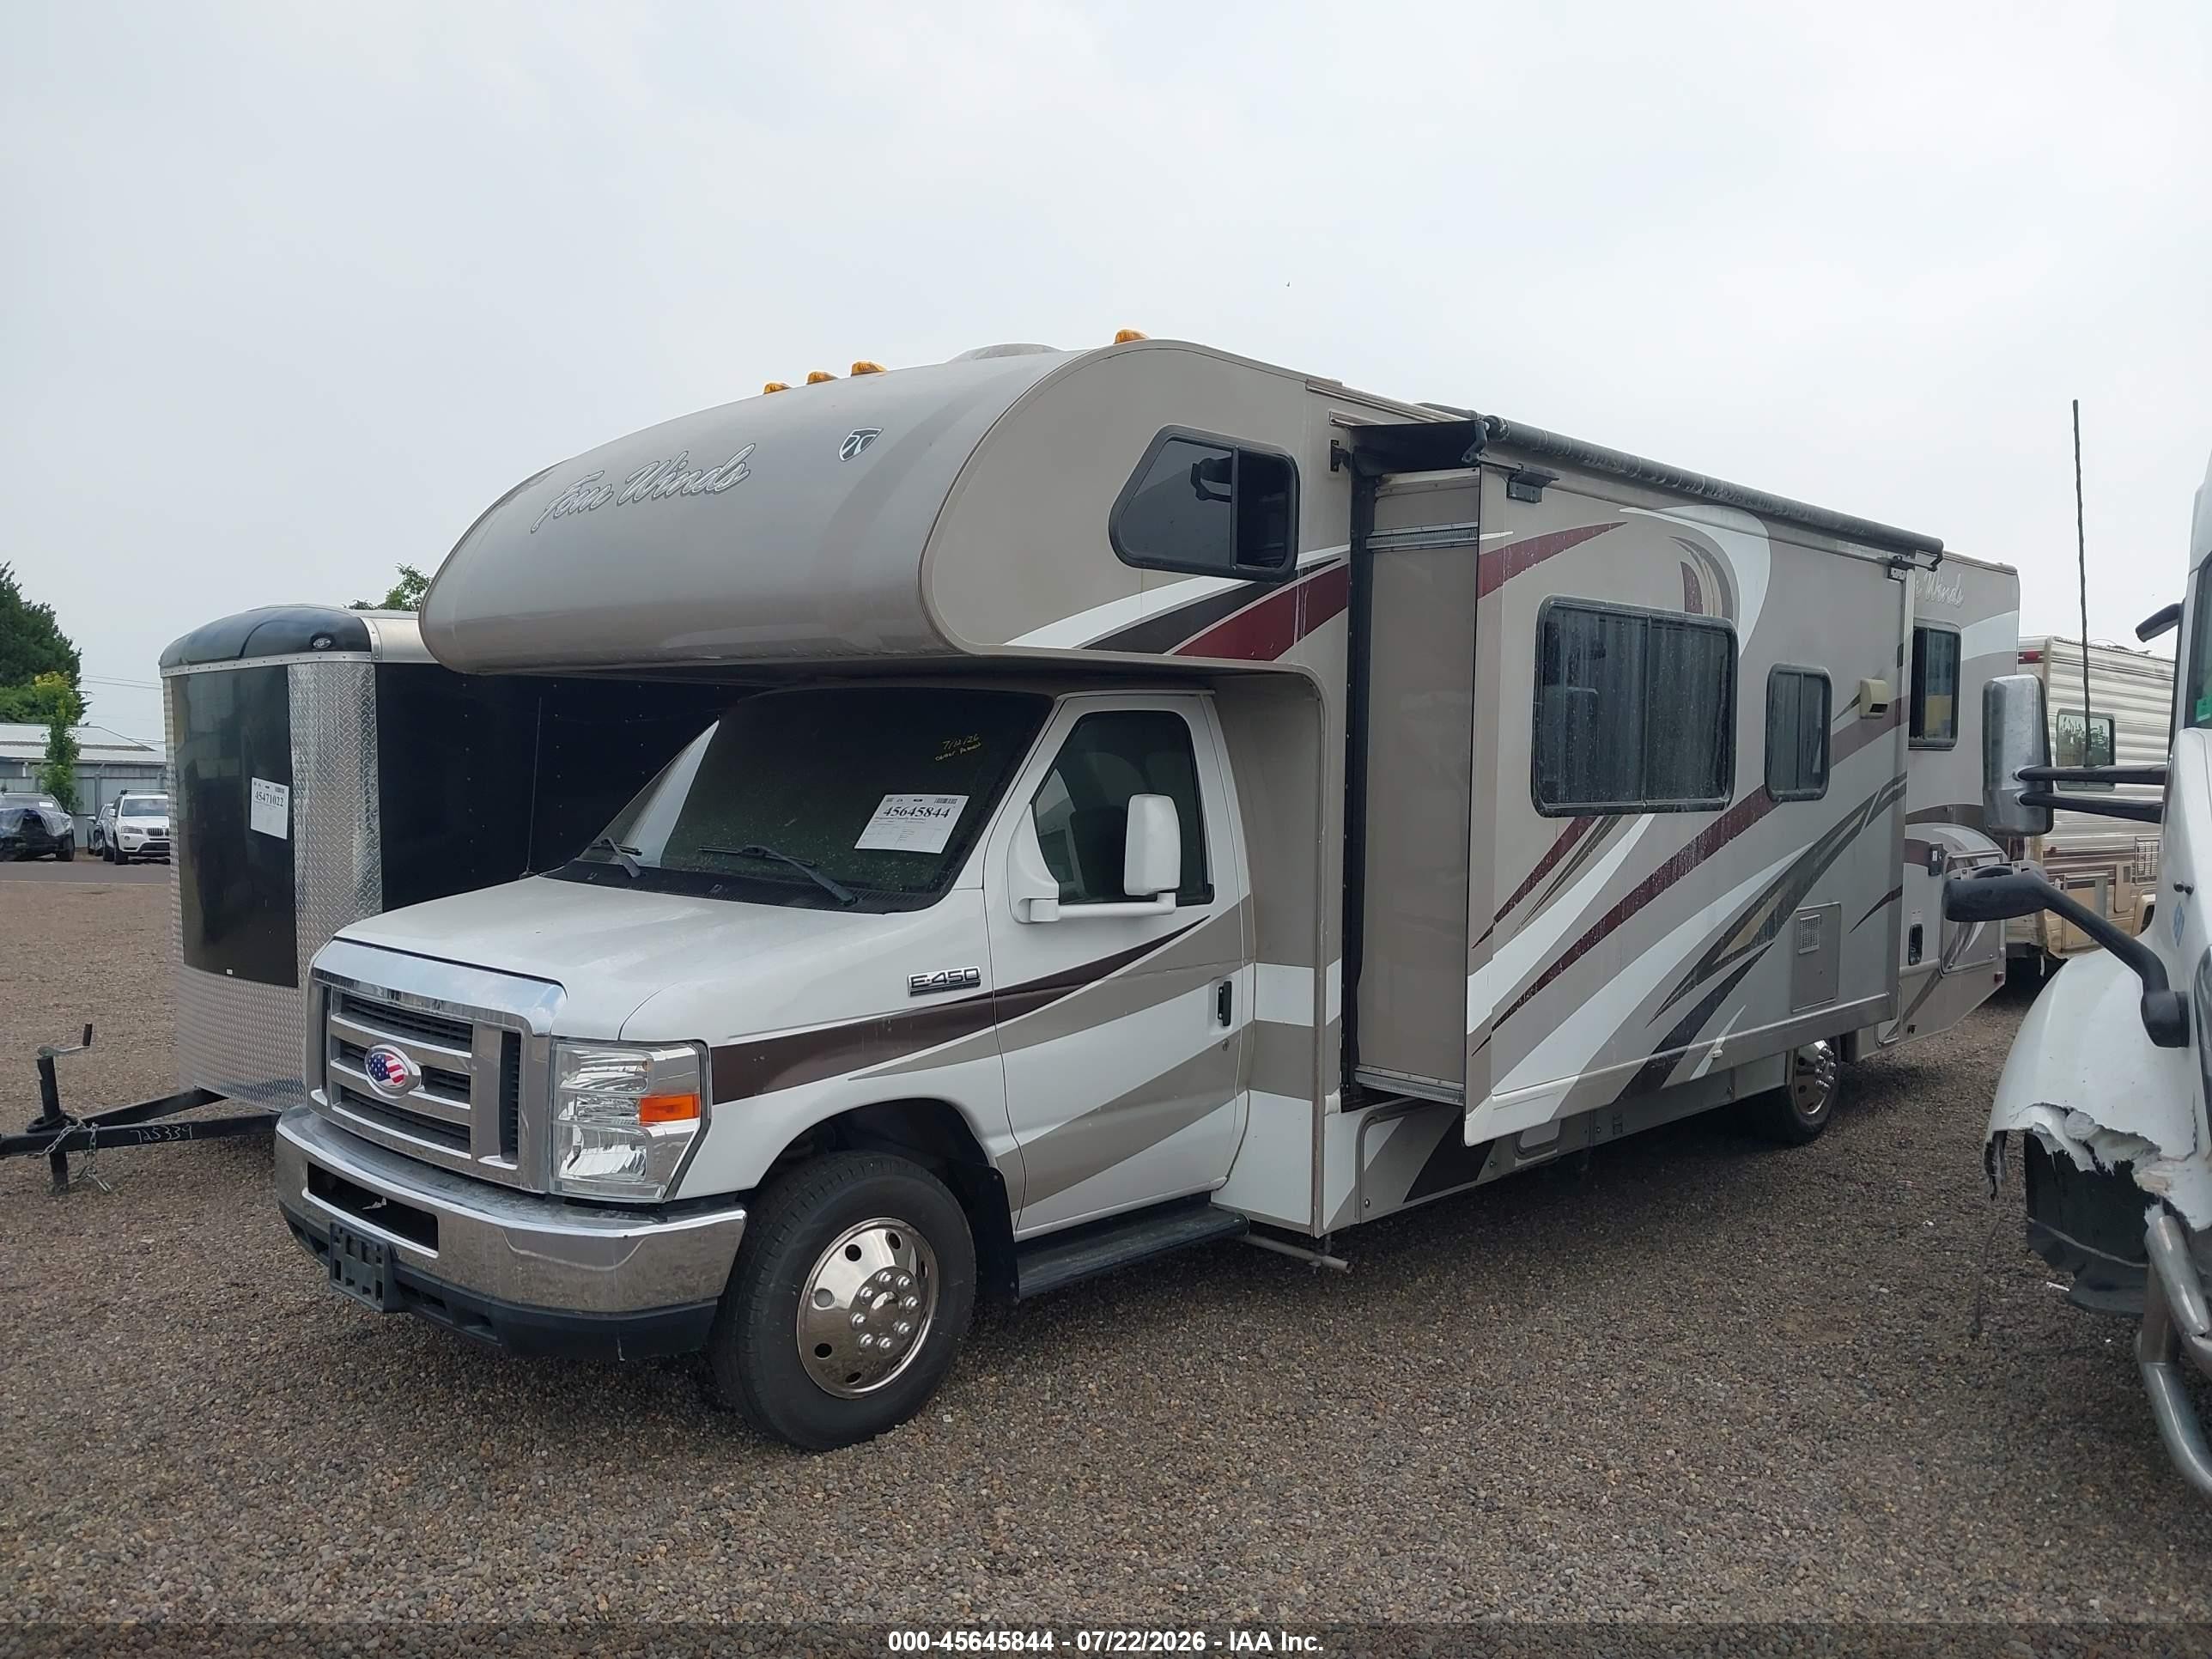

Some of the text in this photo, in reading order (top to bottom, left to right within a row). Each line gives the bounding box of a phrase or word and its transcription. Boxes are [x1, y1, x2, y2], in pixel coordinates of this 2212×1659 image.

[617, 441, 756, 507] Winds
[1924, 569, 1965, 606] Winds
[254, 789, 284, 808] 45471022
[883, 806, 951, 818] 45645844
[909, 967, 981, 988] E-450
